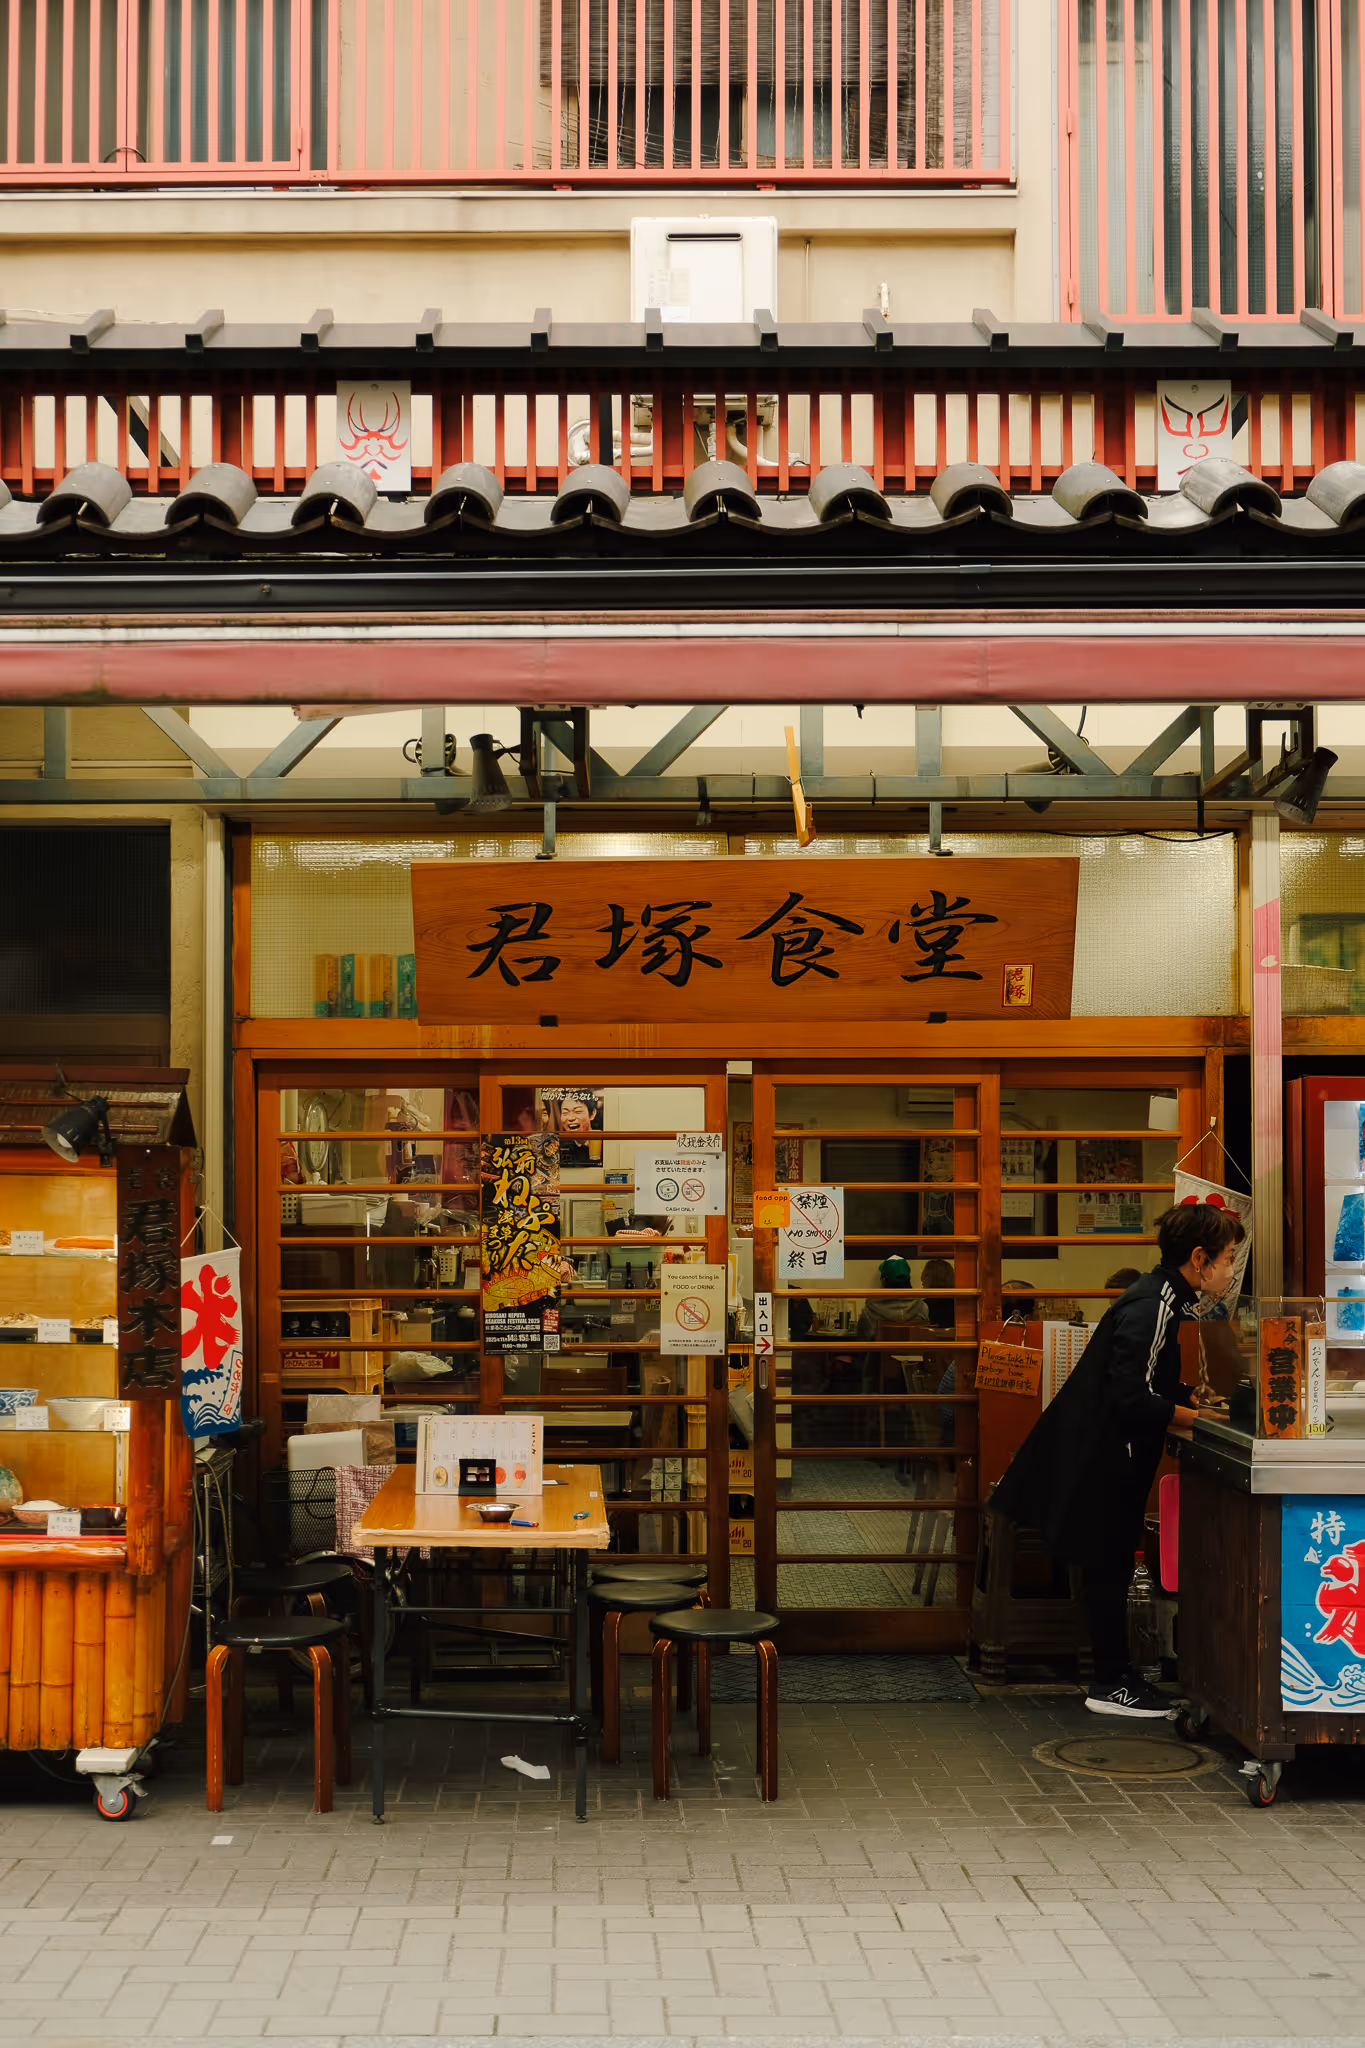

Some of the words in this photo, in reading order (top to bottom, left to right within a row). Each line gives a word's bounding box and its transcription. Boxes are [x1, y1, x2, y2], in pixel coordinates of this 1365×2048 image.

[465, 890, 998, 987] 君塚食堂
[1009, 967, 1026, 1000] 君塚
[677, 1134, 721, 1148] 仅现金支付
[796, 1193, 829, 1209] 禁煙
[788, 1229, 803, 1238] NO
[787, 1250, 828, 1268] 終日
[759, 1297, 768, 1331] 出入口
[1283, 1320, 1298, 1345] 只今
[982, 1345, 1006, 1360] Please
[1007, 1351, 1024, 1364] take
[1026, 1353, 1039, 1366] the
[1311, 1346, 1322, 1378] おでん
[978, 1363, 1005, 1376] garbage
[1007, 1364, 1024, 1378] home
[1267, 1346, 1299, 1431] 営業中
[1308, 1424, 1325, 1434] 150
[743, 1469, 752, 1478] 20
[1310, 1510, 1346, 1546] 特
[743, 1539, 752, 1548] 20
